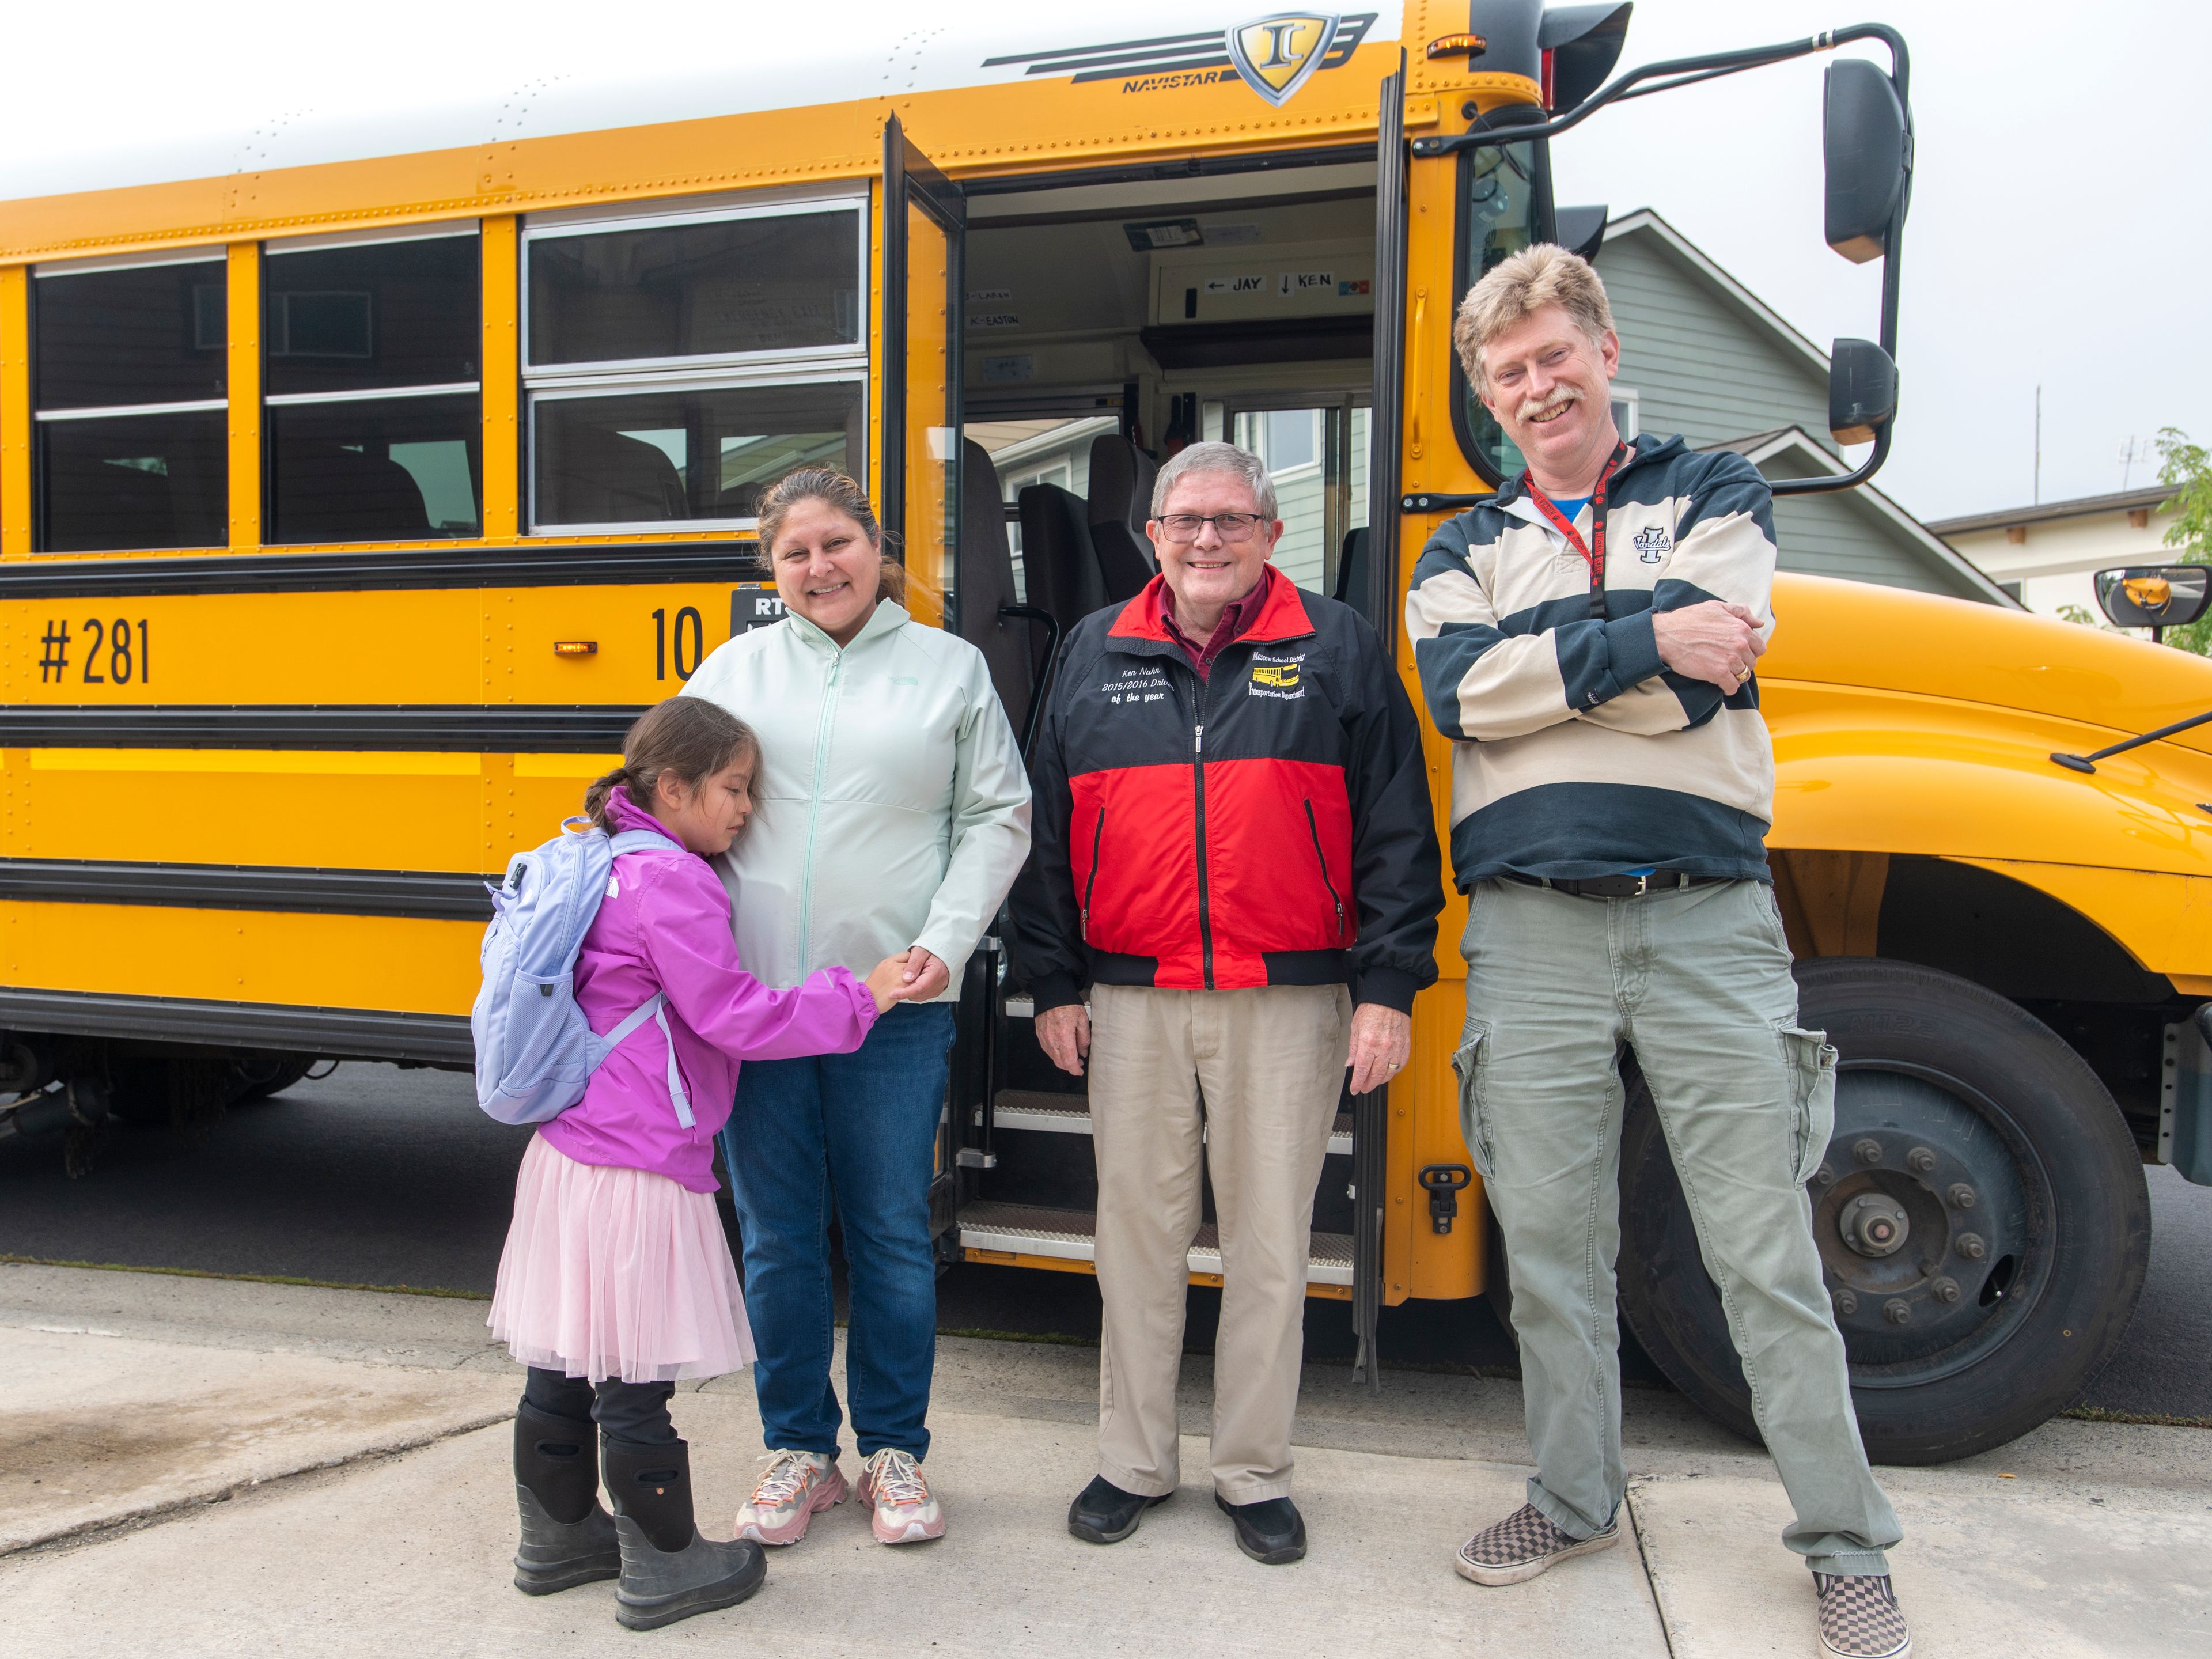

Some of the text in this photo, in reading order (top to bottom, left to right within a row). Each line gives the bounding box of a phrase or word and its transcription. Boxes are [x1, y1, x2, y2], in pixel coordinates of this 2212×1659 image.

[1123, 71, 1218, 94] NAVISTAR
[1233, 276, 1262, 291] JAY
[1298, 273, 1331, 288] KEN
[971, 315, 1019, 326] K-EASTON
[1634, 536, 1671, 551] Vandals
[39, 618, 149, 684] #281
[652, 606, 703, 681] 10
[1252, 652, 1272, 662] Moscow
[1289, 653, 1306, 662] District
[1122, 669, 1137, 677] Ken
[1101, 679, 1148, 691] 2015/2016
[1249, 681, 1305, 701] Transportation Department
[1111, 692, 1165, 704] of the year
